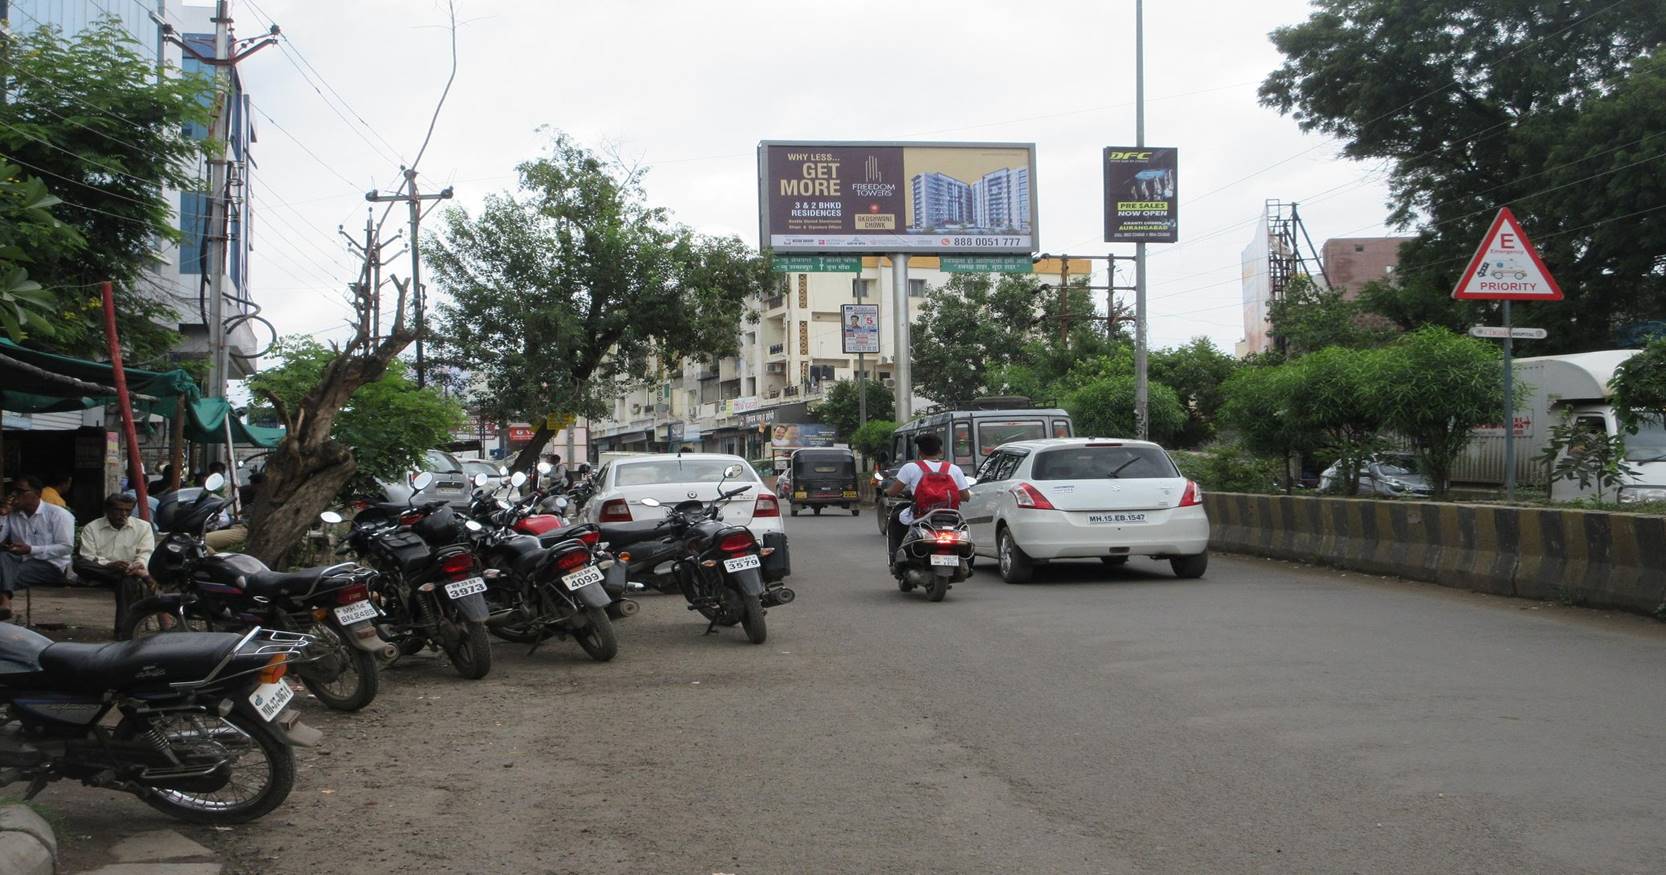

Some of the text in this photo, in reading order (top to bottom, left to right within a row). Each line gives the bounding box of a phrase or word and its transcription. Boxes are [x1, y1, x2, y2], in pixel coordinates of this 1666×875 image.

[788, 153, 840, 161] WHY LESS...
[802, 162, 840, 178] GET
[780, 179, 841, 196] MORE
[954, 237, 1021, 246] 888 0051 777
[1501, 233, 1515, 249] E
[1480, 282, 1537, 291] PRIORITY
[729, 559, 758, 570] 3579
[571, 572, 600, 587] 4099
[450, 583, 485, 598] 3973
